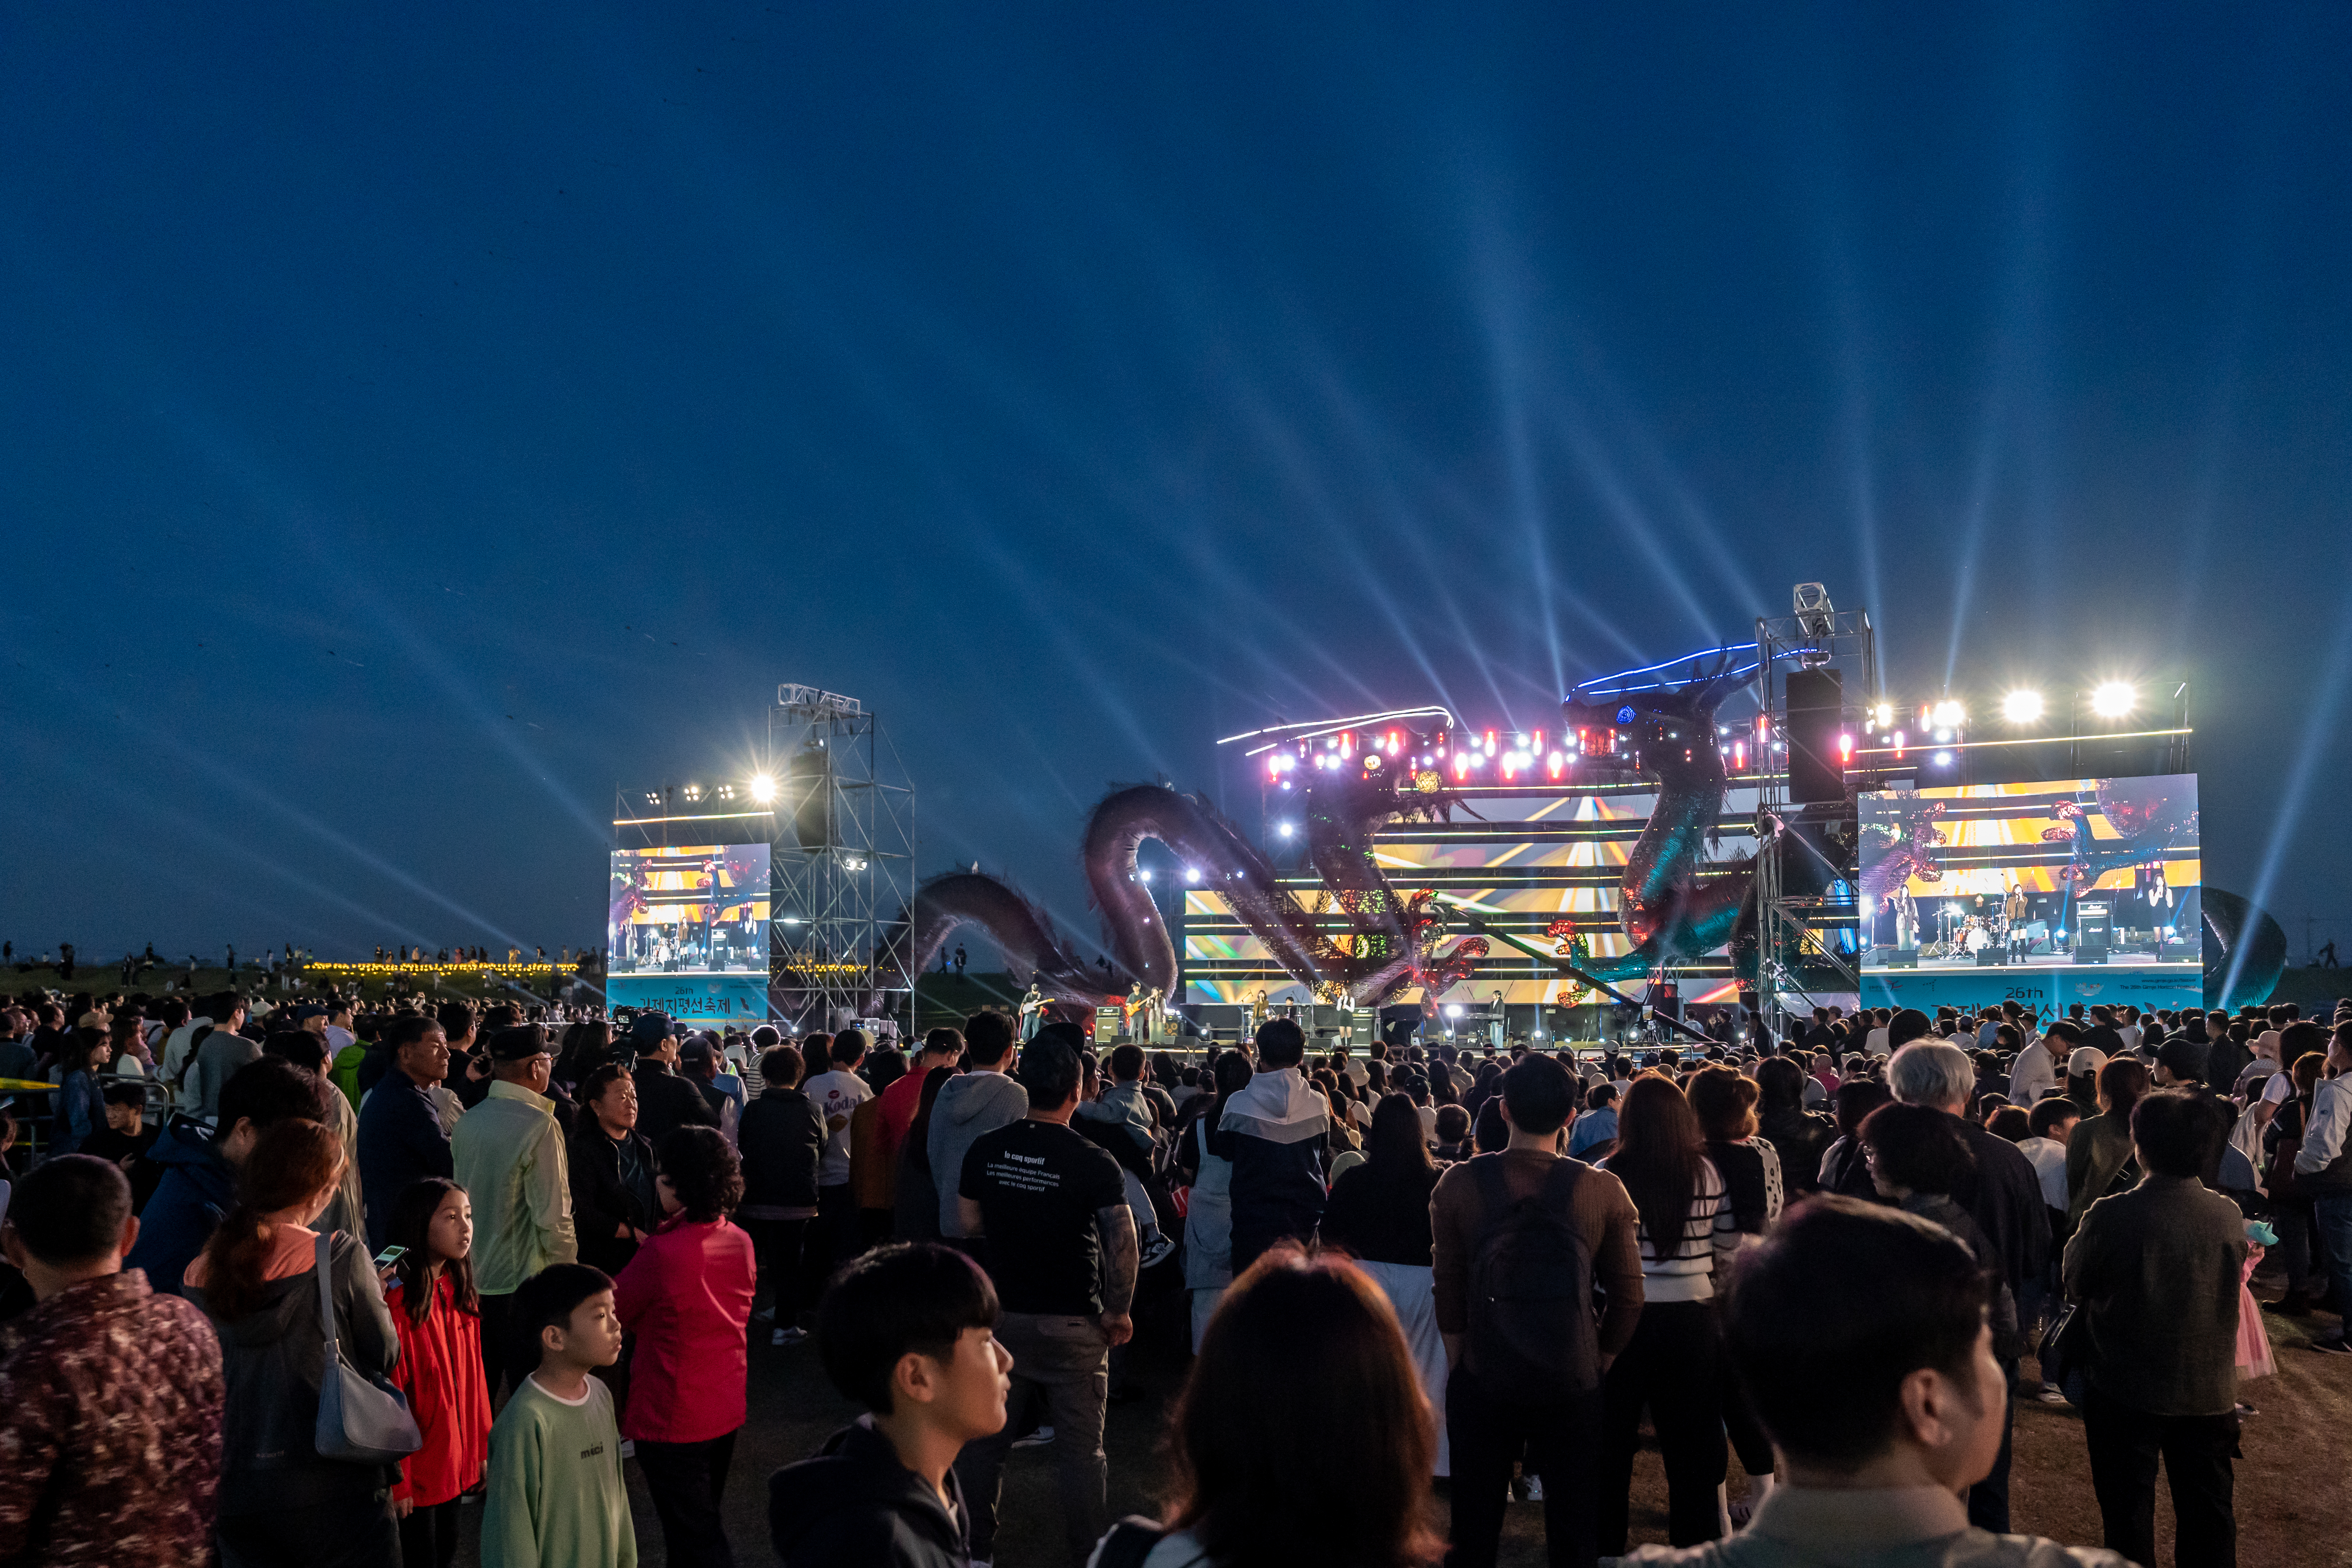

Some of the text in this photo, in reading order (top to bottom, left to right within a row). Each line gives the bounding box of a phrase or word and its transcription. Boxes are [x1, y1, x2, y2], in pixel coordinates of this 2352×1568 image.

[675, 986, 693, 994] 26th
[2005, 986, 2043, 999] 26th
[1011, 1154, 1023, 1163] coq
[1024, 1156, 1045, 1165] sportif
[996, 1172, 1022, 1180] meilleures
[1023, 1176, 1059, 1187] performances
